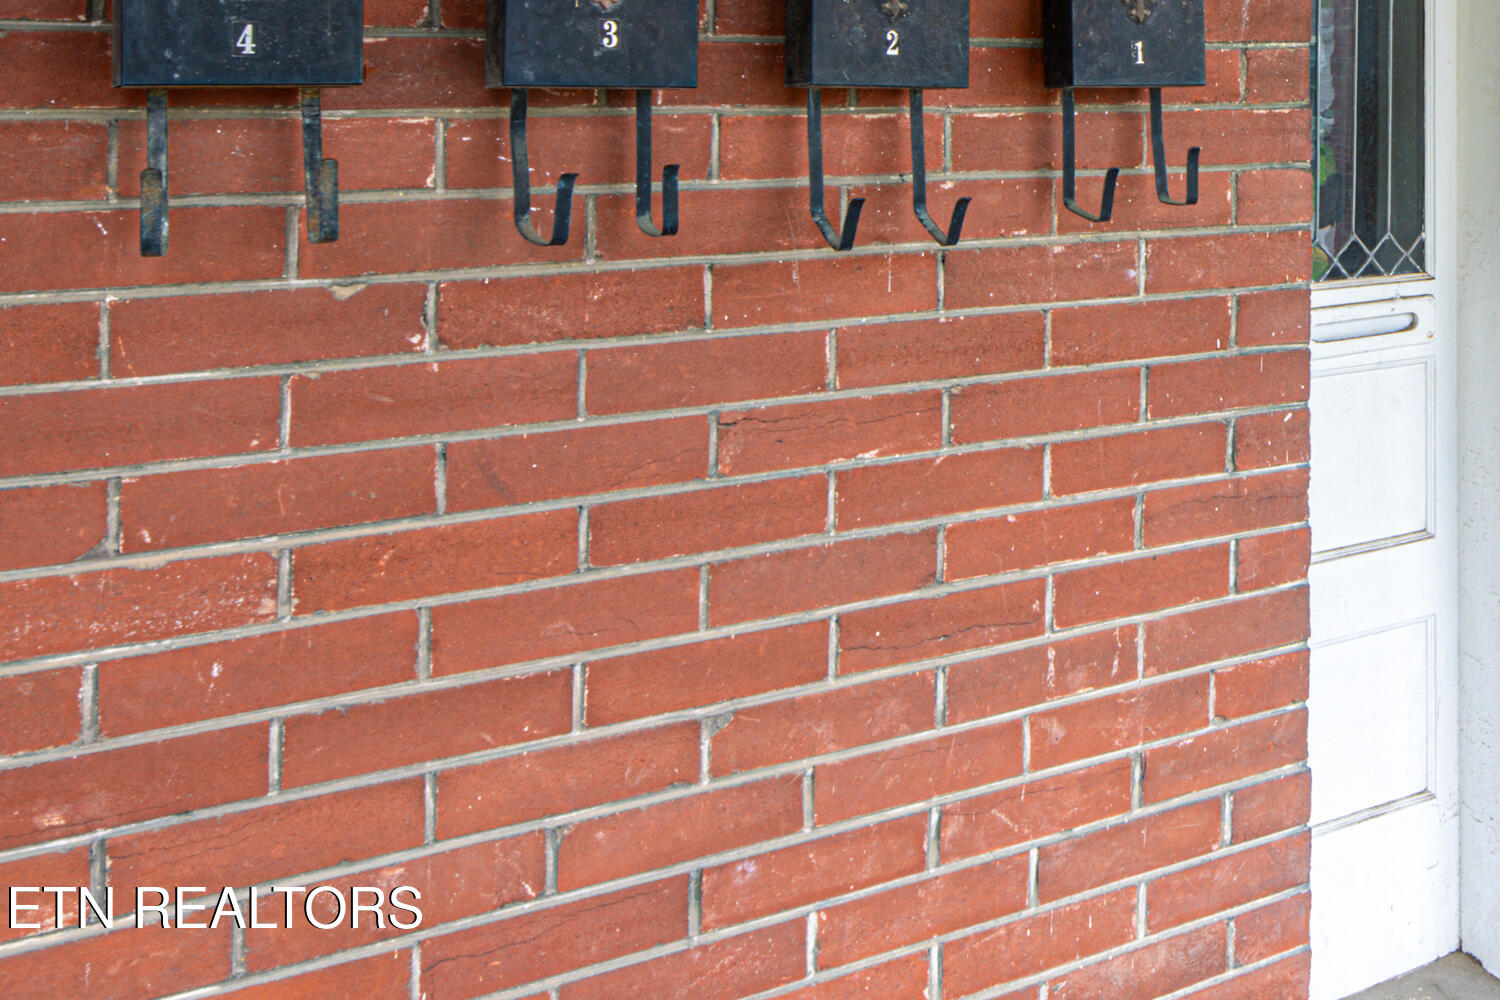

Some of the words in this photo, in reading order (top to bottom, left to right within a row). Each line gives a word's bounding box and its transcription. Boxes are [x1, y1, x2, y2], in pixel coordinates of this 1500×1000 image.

[236, 24, 256, 55] 4
[602, 20, 618, 48] 3
[886, 29, 899, 56] 2
[1132, 40, 1145, 65] 1
